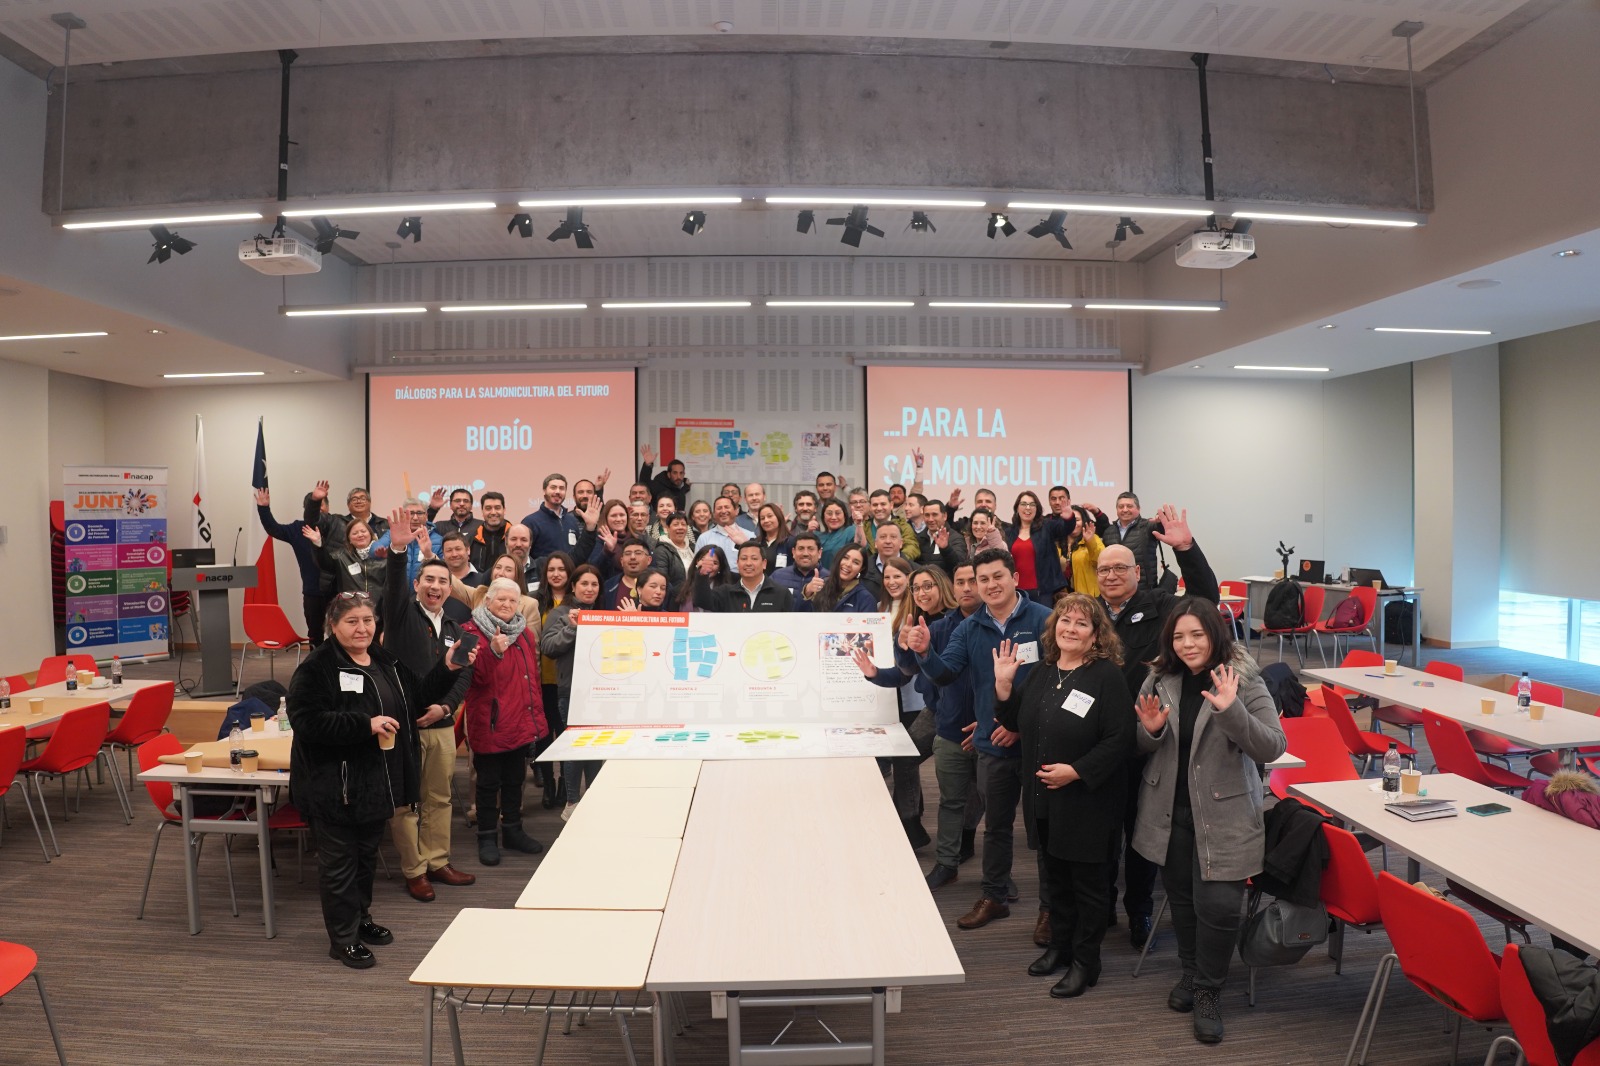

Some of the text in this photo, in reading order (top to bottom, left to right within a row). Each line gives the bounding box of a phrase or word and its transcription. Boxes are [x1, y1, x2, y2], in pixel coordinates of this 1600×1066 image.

[395, 384, 609, 400] DIÁLOGOS PARA LA SALMONICULTURA DEL FUTURO
[466, 417, 533, 451] BIOBÍO
[977, 408, 1006, 438] LA
